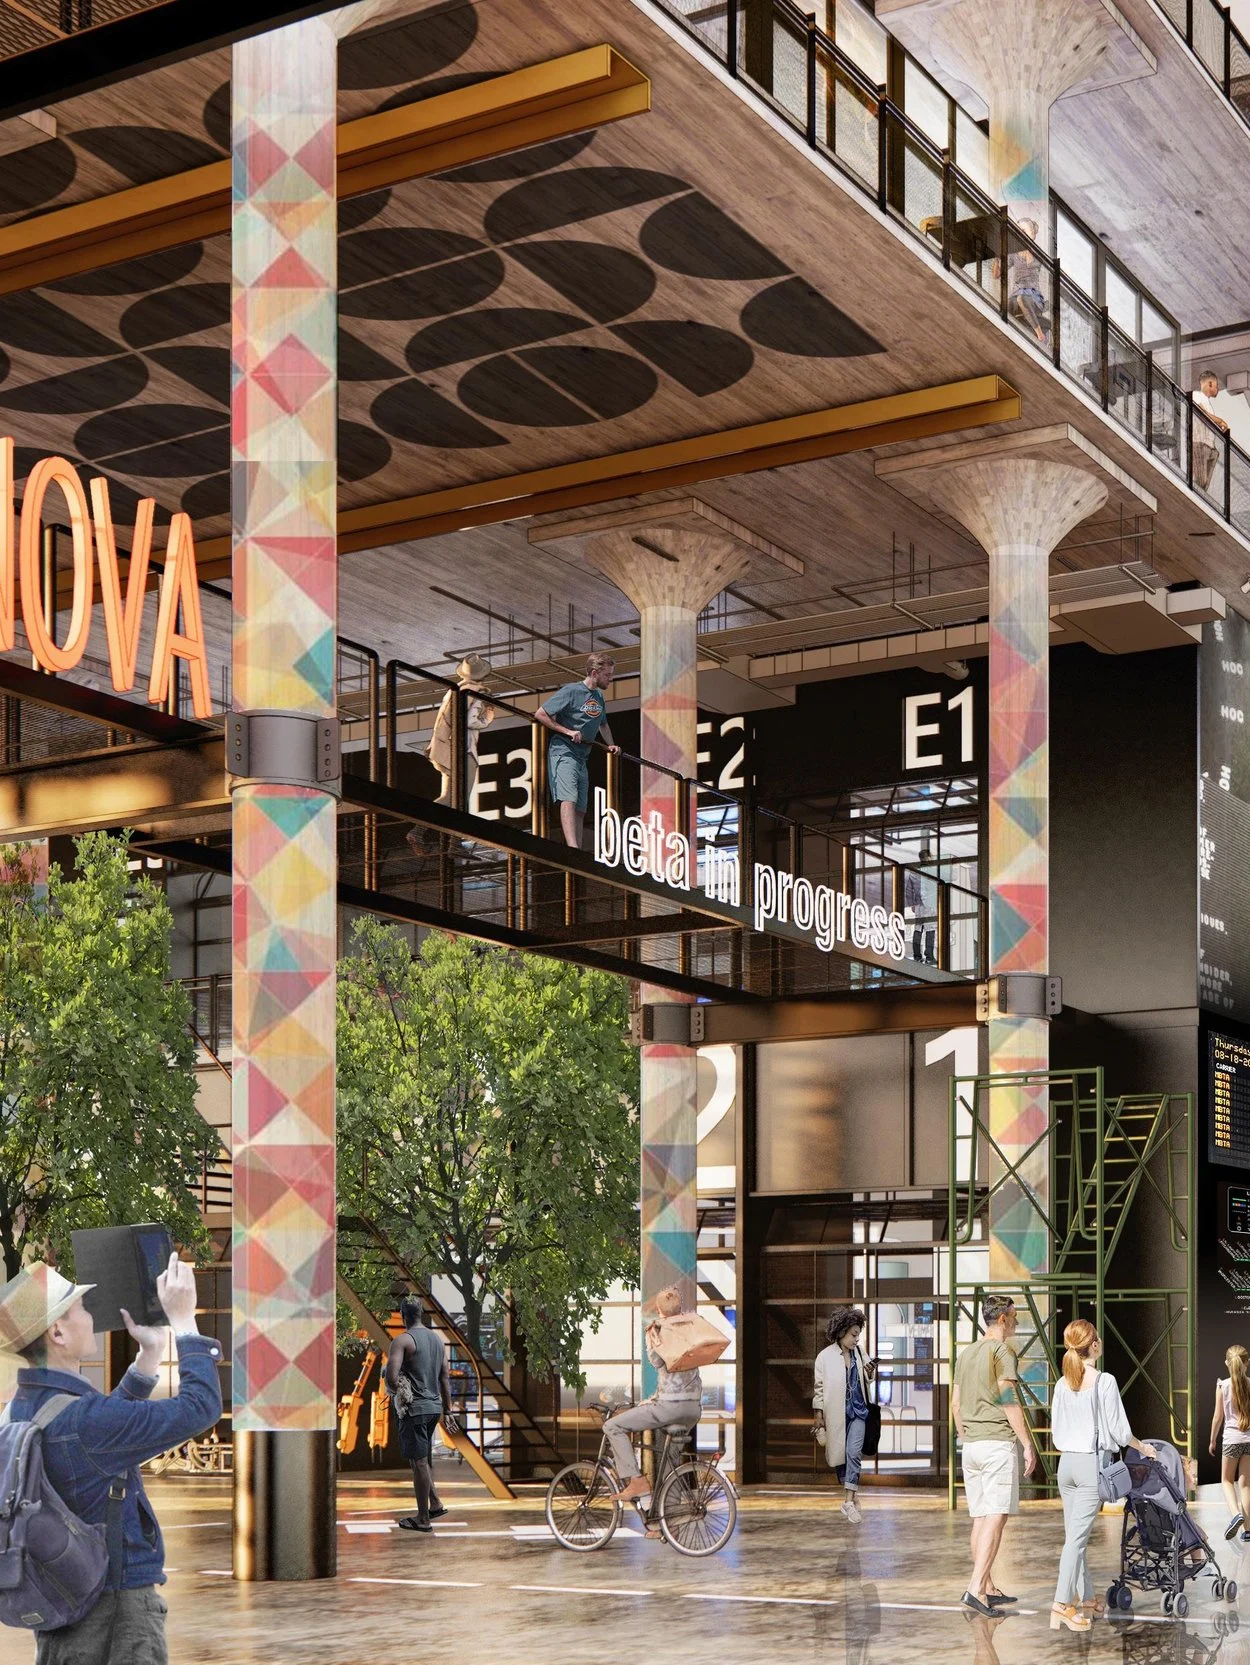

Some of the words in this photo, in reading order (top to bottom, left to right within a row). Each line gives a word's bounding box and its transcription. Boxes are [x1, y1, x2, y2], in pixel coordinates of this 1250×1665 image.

[906, 686, 973, 769] E1
[594, 786, 690, 891] beta
[705, 826, 740, 907] in
[755, 861, 905, 960] progress
[925, 1025, 978, 1182] 1
